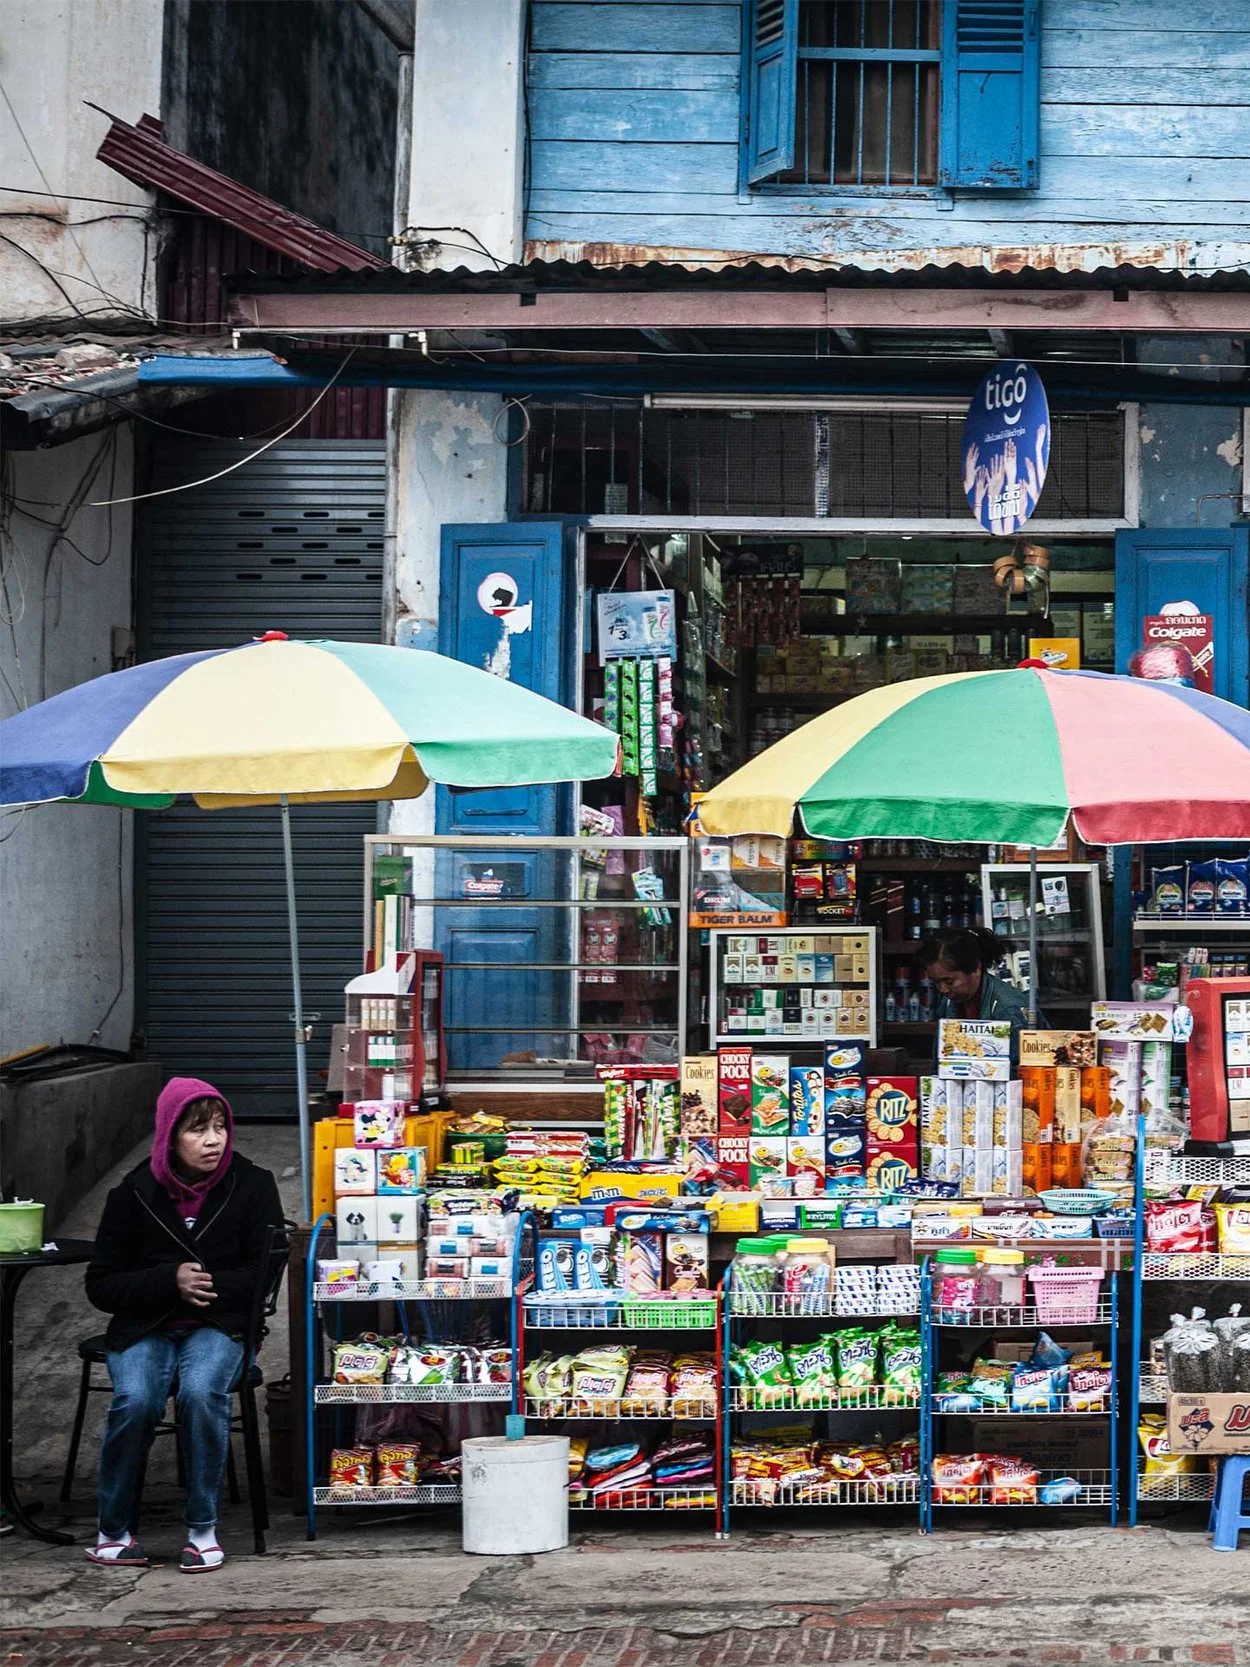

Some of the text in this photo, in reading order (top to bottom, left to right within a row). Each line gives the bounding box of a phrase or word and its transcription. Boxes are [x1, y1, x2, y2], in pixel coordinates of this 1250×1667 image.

[1149, 627, 1206, 639] Colgate
[701, 914, 773, 924] TIGER BALM
[1022, 1040, 1051, 1054] Cookies
[720, 1054, 750, 1064] CHOCKY
[685, 1066, 715, 1080] Cookies
[720, 1065, 750, 1079] POCK
[879, 1096, 907, 1122] RITZ
[719, 1138, 749, 1148] CHOCKY
[720, 1149, 749, 1163] POCK
[880, 1165, 907, 1189] RITZ
